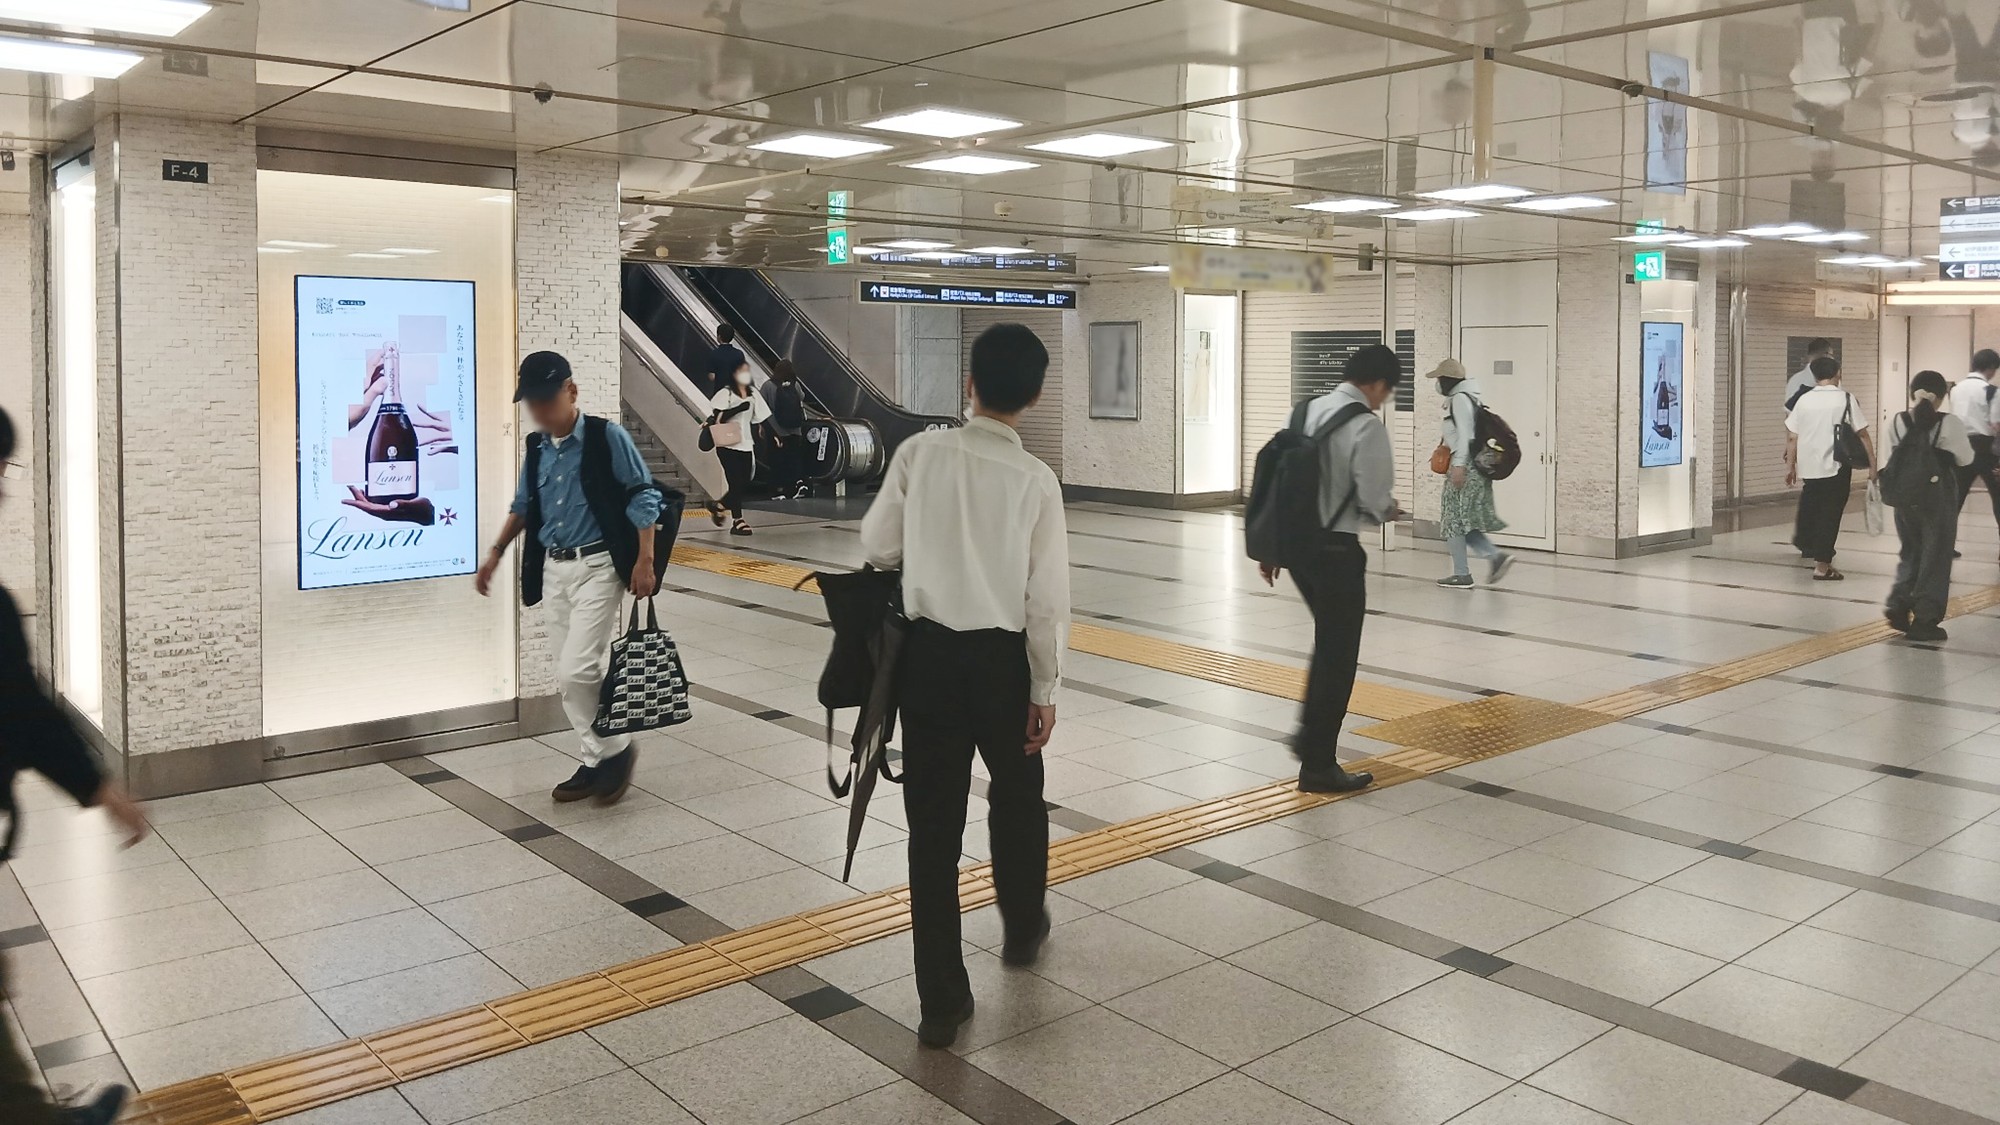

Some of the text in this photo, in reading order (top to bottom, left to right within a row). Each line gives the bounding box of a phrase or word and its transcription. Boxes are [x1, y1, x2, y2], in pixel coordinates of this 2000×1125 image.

[171, 164, 199, 178] F-4
[374, 469, 413, 487] Lanson
[304, 516, 425, 560] Lanson
